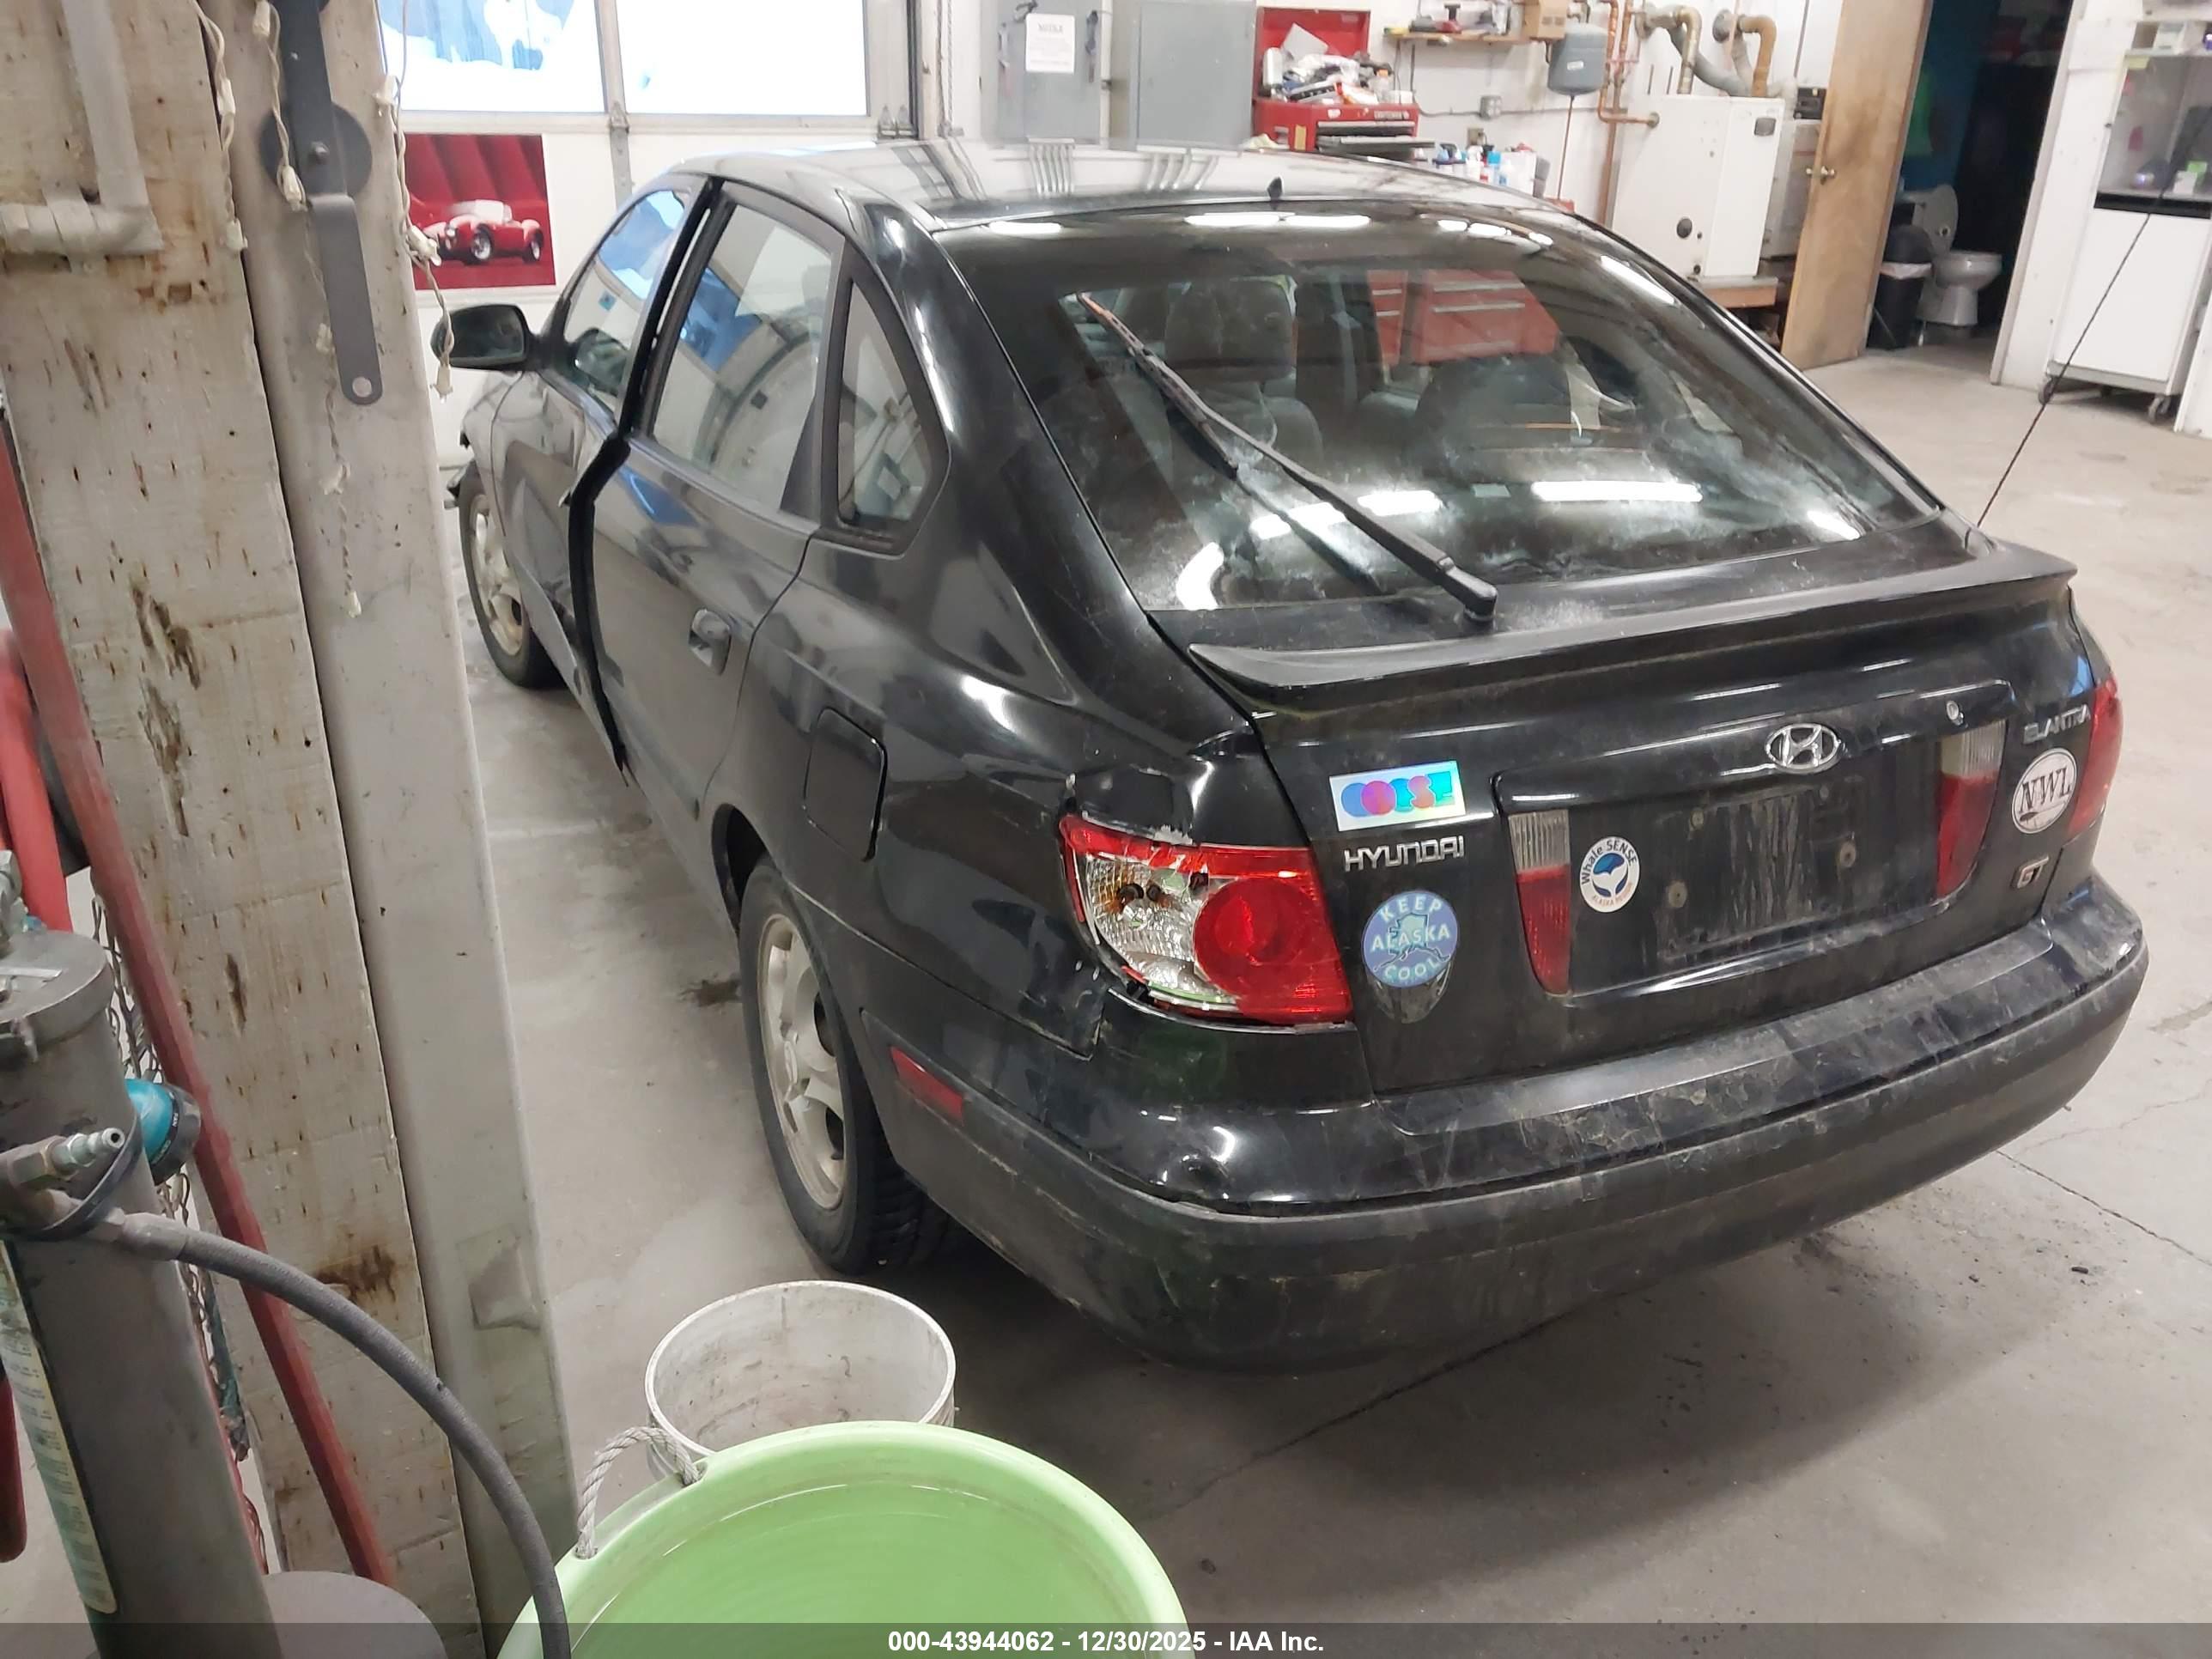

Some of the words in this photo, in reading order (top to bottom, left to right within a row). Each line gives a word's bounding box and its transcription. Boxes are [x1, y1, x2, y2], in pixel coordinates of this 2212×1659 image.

[2018, 766, 2073, 815] NWL
[1344, 835, 1464, 872] HYUNDAI
[1581, 846, 1603, 885] Whale
[1606, 839, 1638, 866] SENSE
[1380, 895, 1443, 923] KEEP
[1370, 923, 1450, 952] ALASKA
[1383, 957, 1440, 981] COOL
